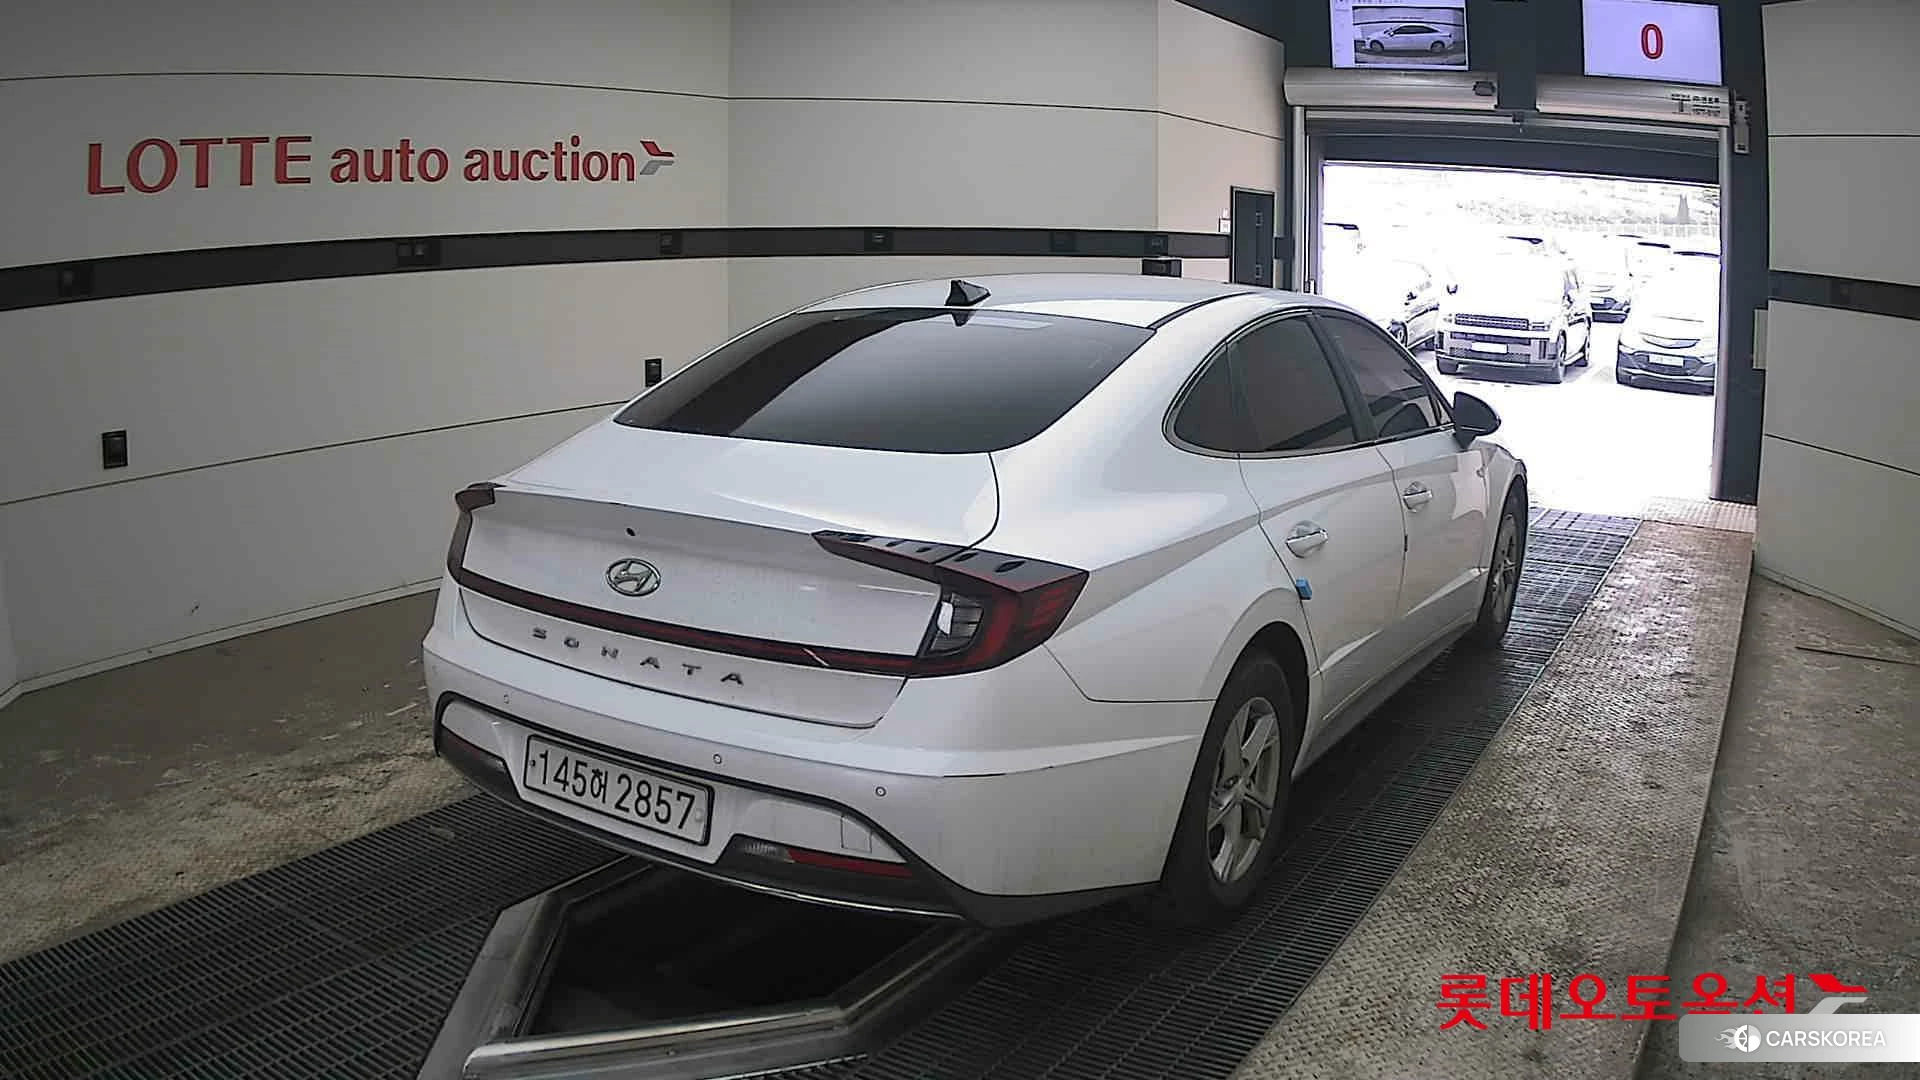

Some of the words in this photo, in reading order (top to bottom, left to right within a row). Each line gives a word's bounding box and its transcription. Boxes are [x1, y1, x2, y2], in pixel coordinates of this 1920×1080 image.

[1641, 23, 1663, 59] 0
[87, 135, 312, 195] LOTTE
[329, 138, 449, 183] auto
[463, 135, 635, 182] auction
[532, 627, 744, 686] SONATA
